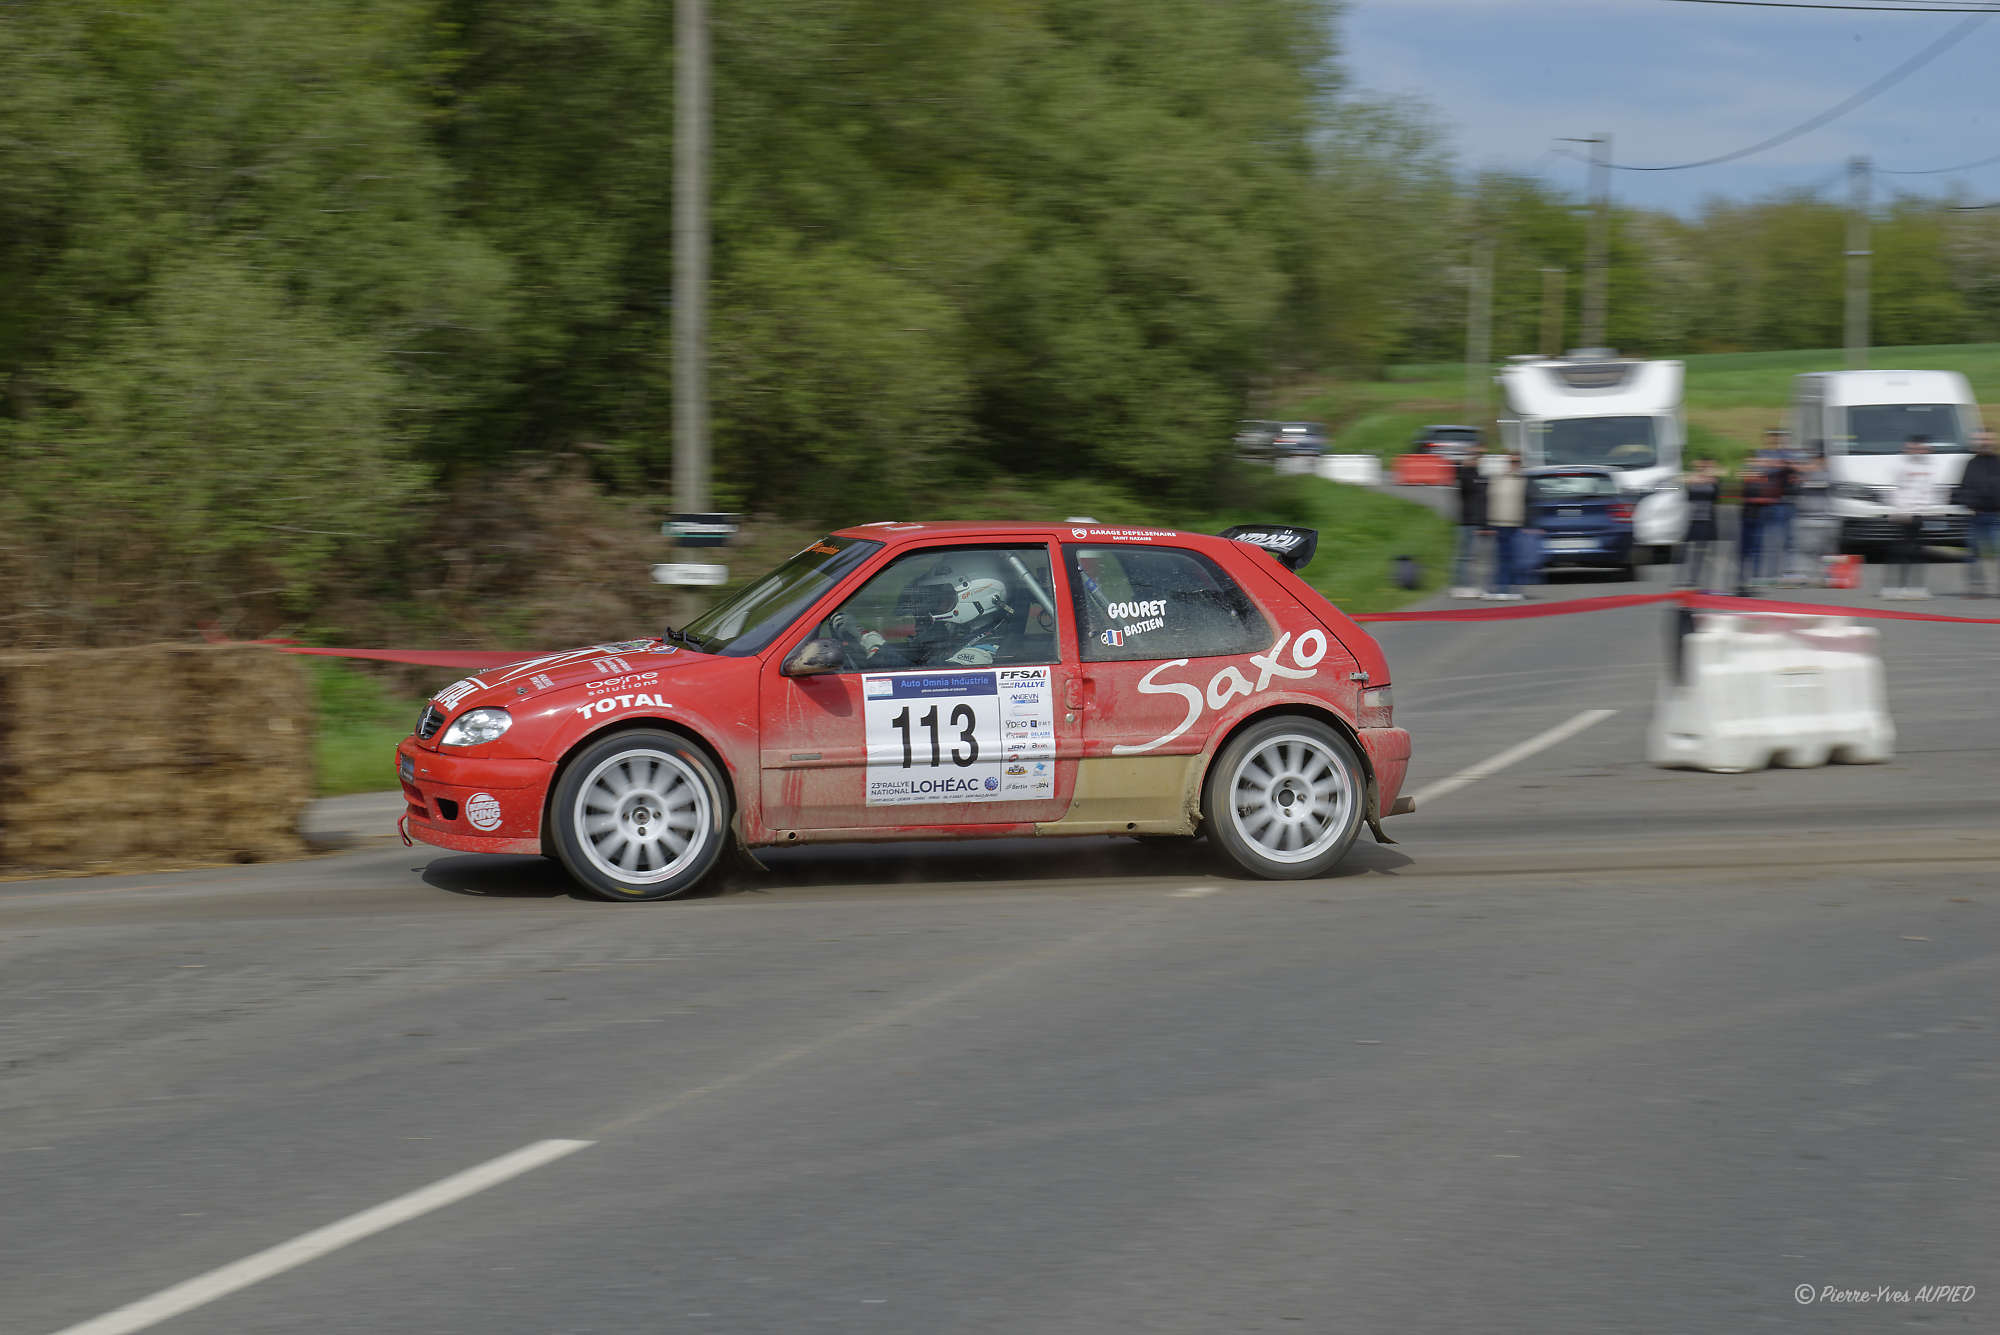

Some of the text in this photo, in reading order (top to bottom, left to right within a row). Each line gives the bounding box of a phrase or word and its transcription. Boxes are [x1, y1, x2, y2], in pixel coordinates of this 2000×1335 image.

[1108, 600, 1167, 619] GOURET
[1124, 617, 1164, 637] BASTIEN
[1000, 670, 1041, 679] FFSA
[588, 680, 658, 696] solutions
[923, 679, 949, 687] Omnia
[576, 694, 672, 720] TOTAL
[892, 703, 979, 768] 113
[871, 788, 909, 796] NATIONAL
[911, 777, 978, 793] LOHÉAC
[471, 808, 501, 822] KING
